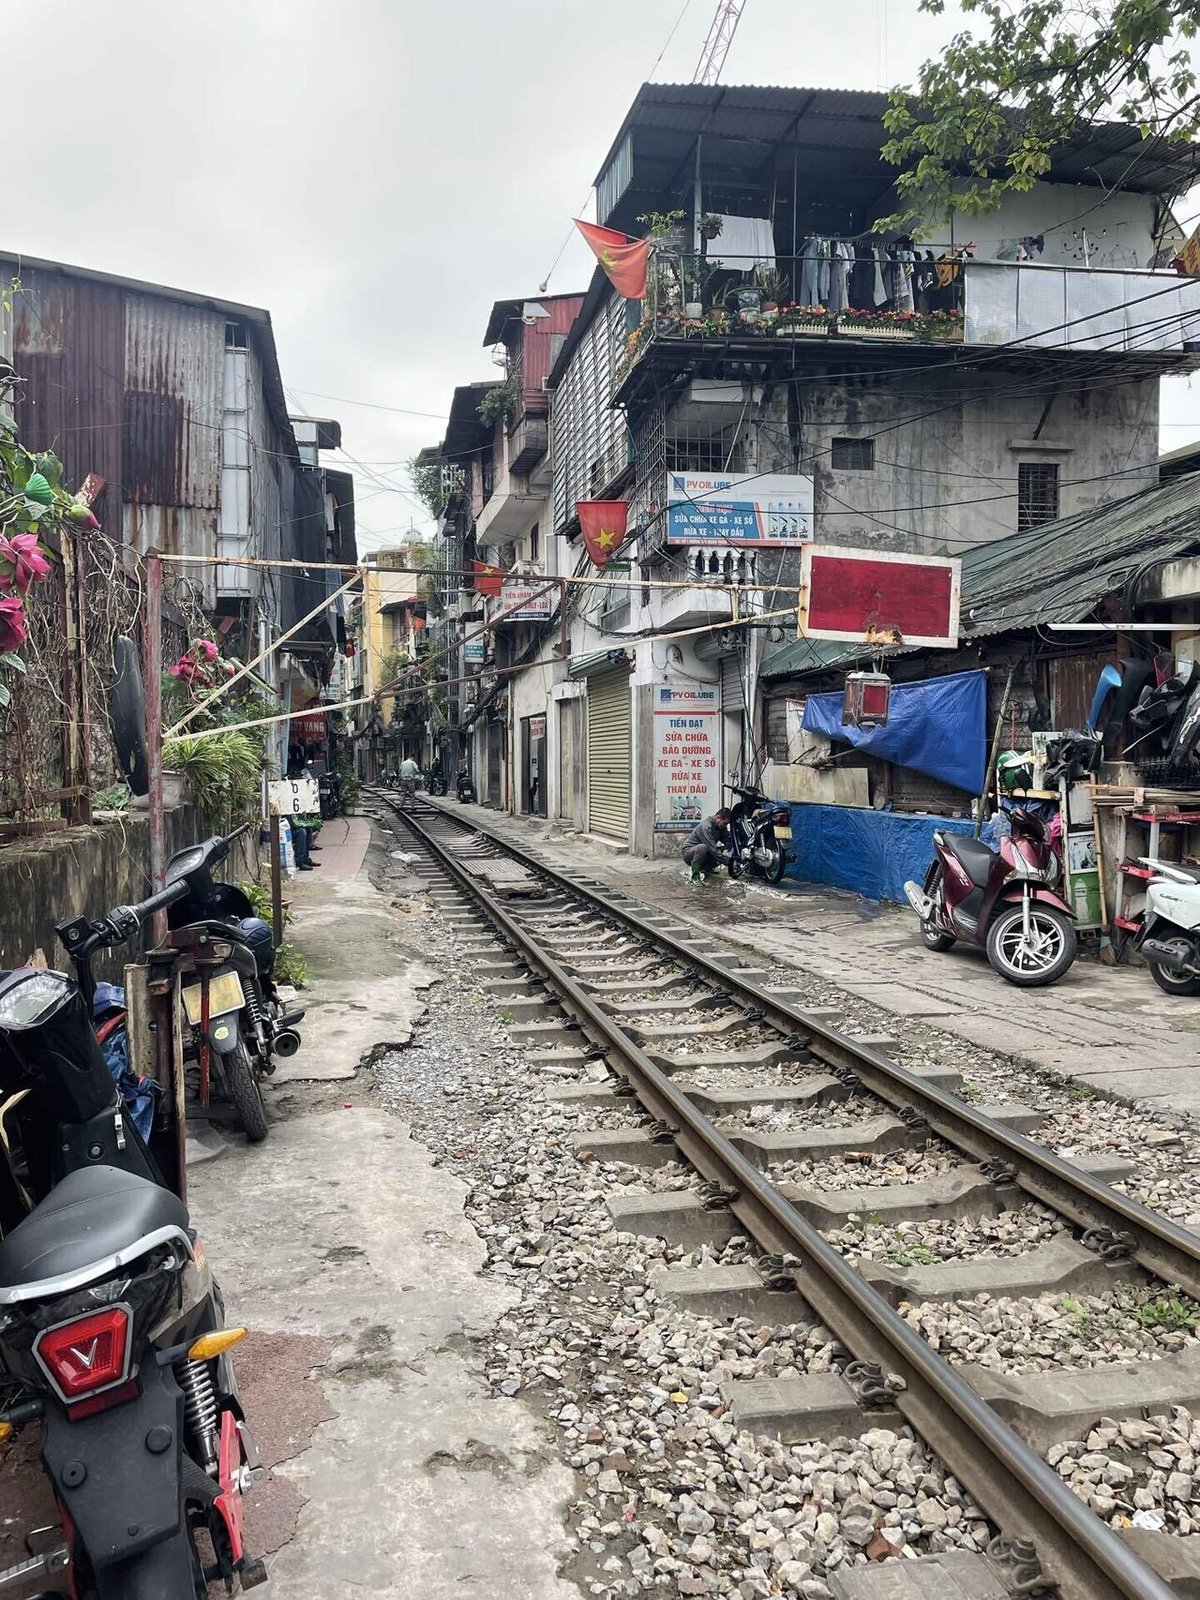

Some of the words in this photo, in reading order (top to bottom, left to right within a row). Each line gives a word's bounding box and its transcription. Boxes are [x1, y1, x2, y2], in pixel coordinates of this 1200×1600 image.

[709, 516, 718, 524] XE
[719, 516, 728, 524] GA
[733, 517, 743, 525] XE
[698, 528, 707, 536] XE
[669, 717, 687, 728] TIẾN
[688, 719, 704, 730] ĐẠT
[665, 731, 683, 742] SỬA
[685, 732, 708, 742] CHỮA
[662, 744, 680, 755] BẢO
[682, 745, 711, 755] DƯỠNG
[657, 759, 669, 768] XE
[671, 759, 683, 768] GA
[691, 759, 702, 768] XE
[704, 757, 716, 768] SỐ
[671, 770, 689, 781] RỬA
[691, 772, 703, 781] XE
[666, 785, 687, 794] THAY
[292, 797, 300, 812] 6
